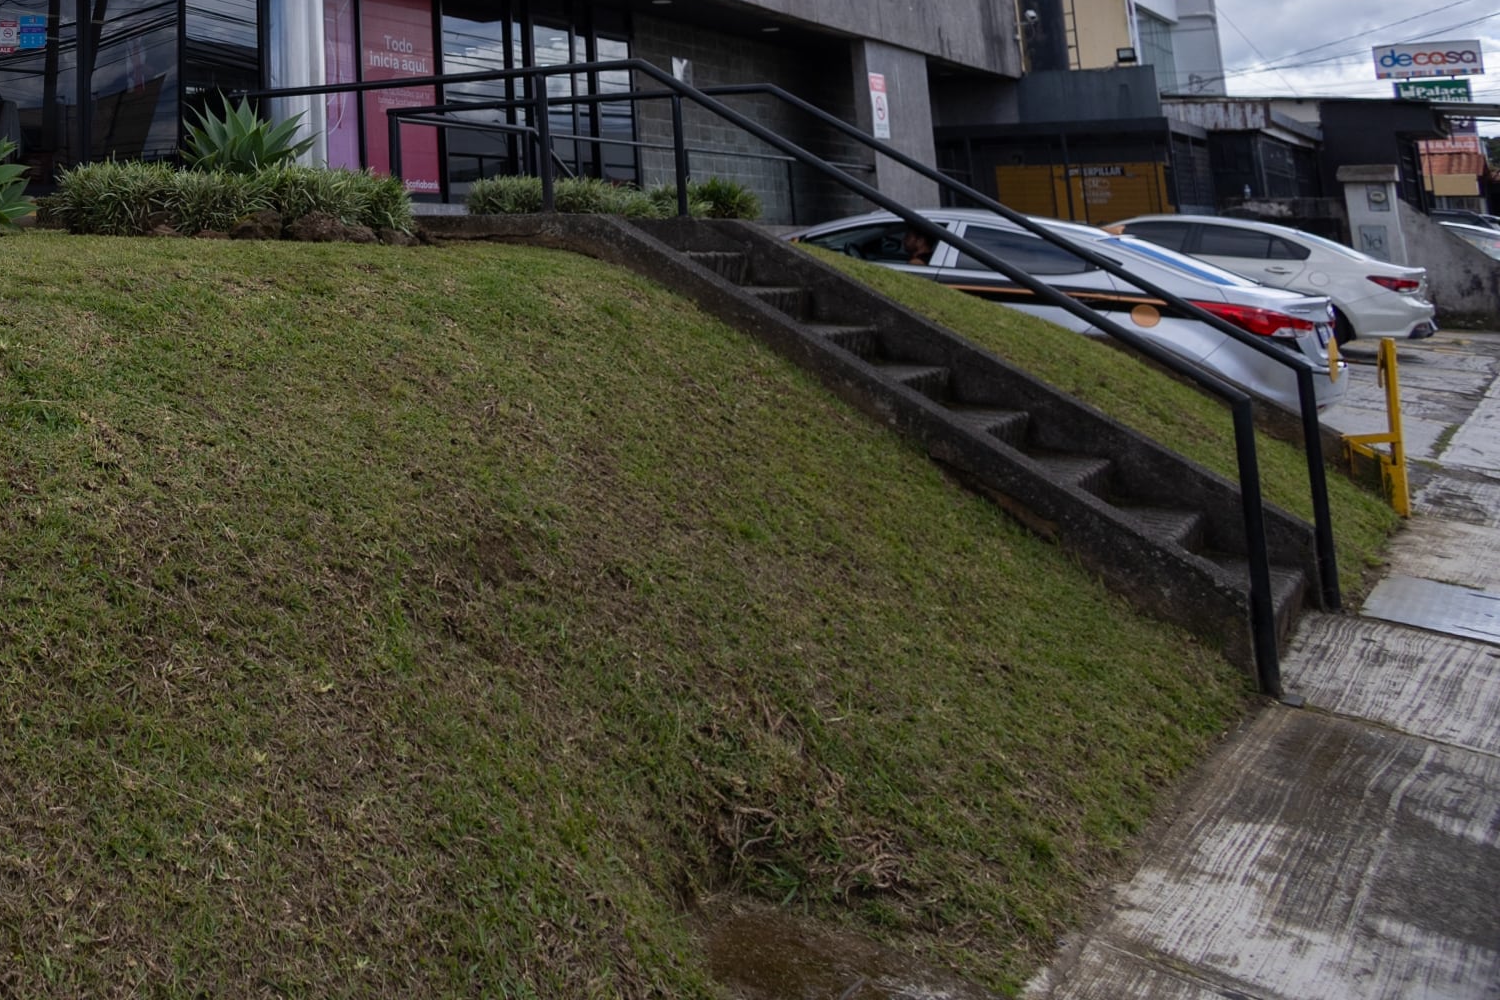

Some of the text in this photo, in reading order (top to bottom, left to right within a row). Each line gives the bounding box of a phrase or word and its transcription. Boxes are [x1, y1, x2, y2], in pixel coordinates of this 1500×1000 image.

[384, 34, 413, 54] Todo
[369, 50, 400, 70] inicia
[1380, 49, 1477, 68] decasa
[1415, 85, 1467, 96] Palace
[1068, 166, 1122, 177] ERPILLAR
